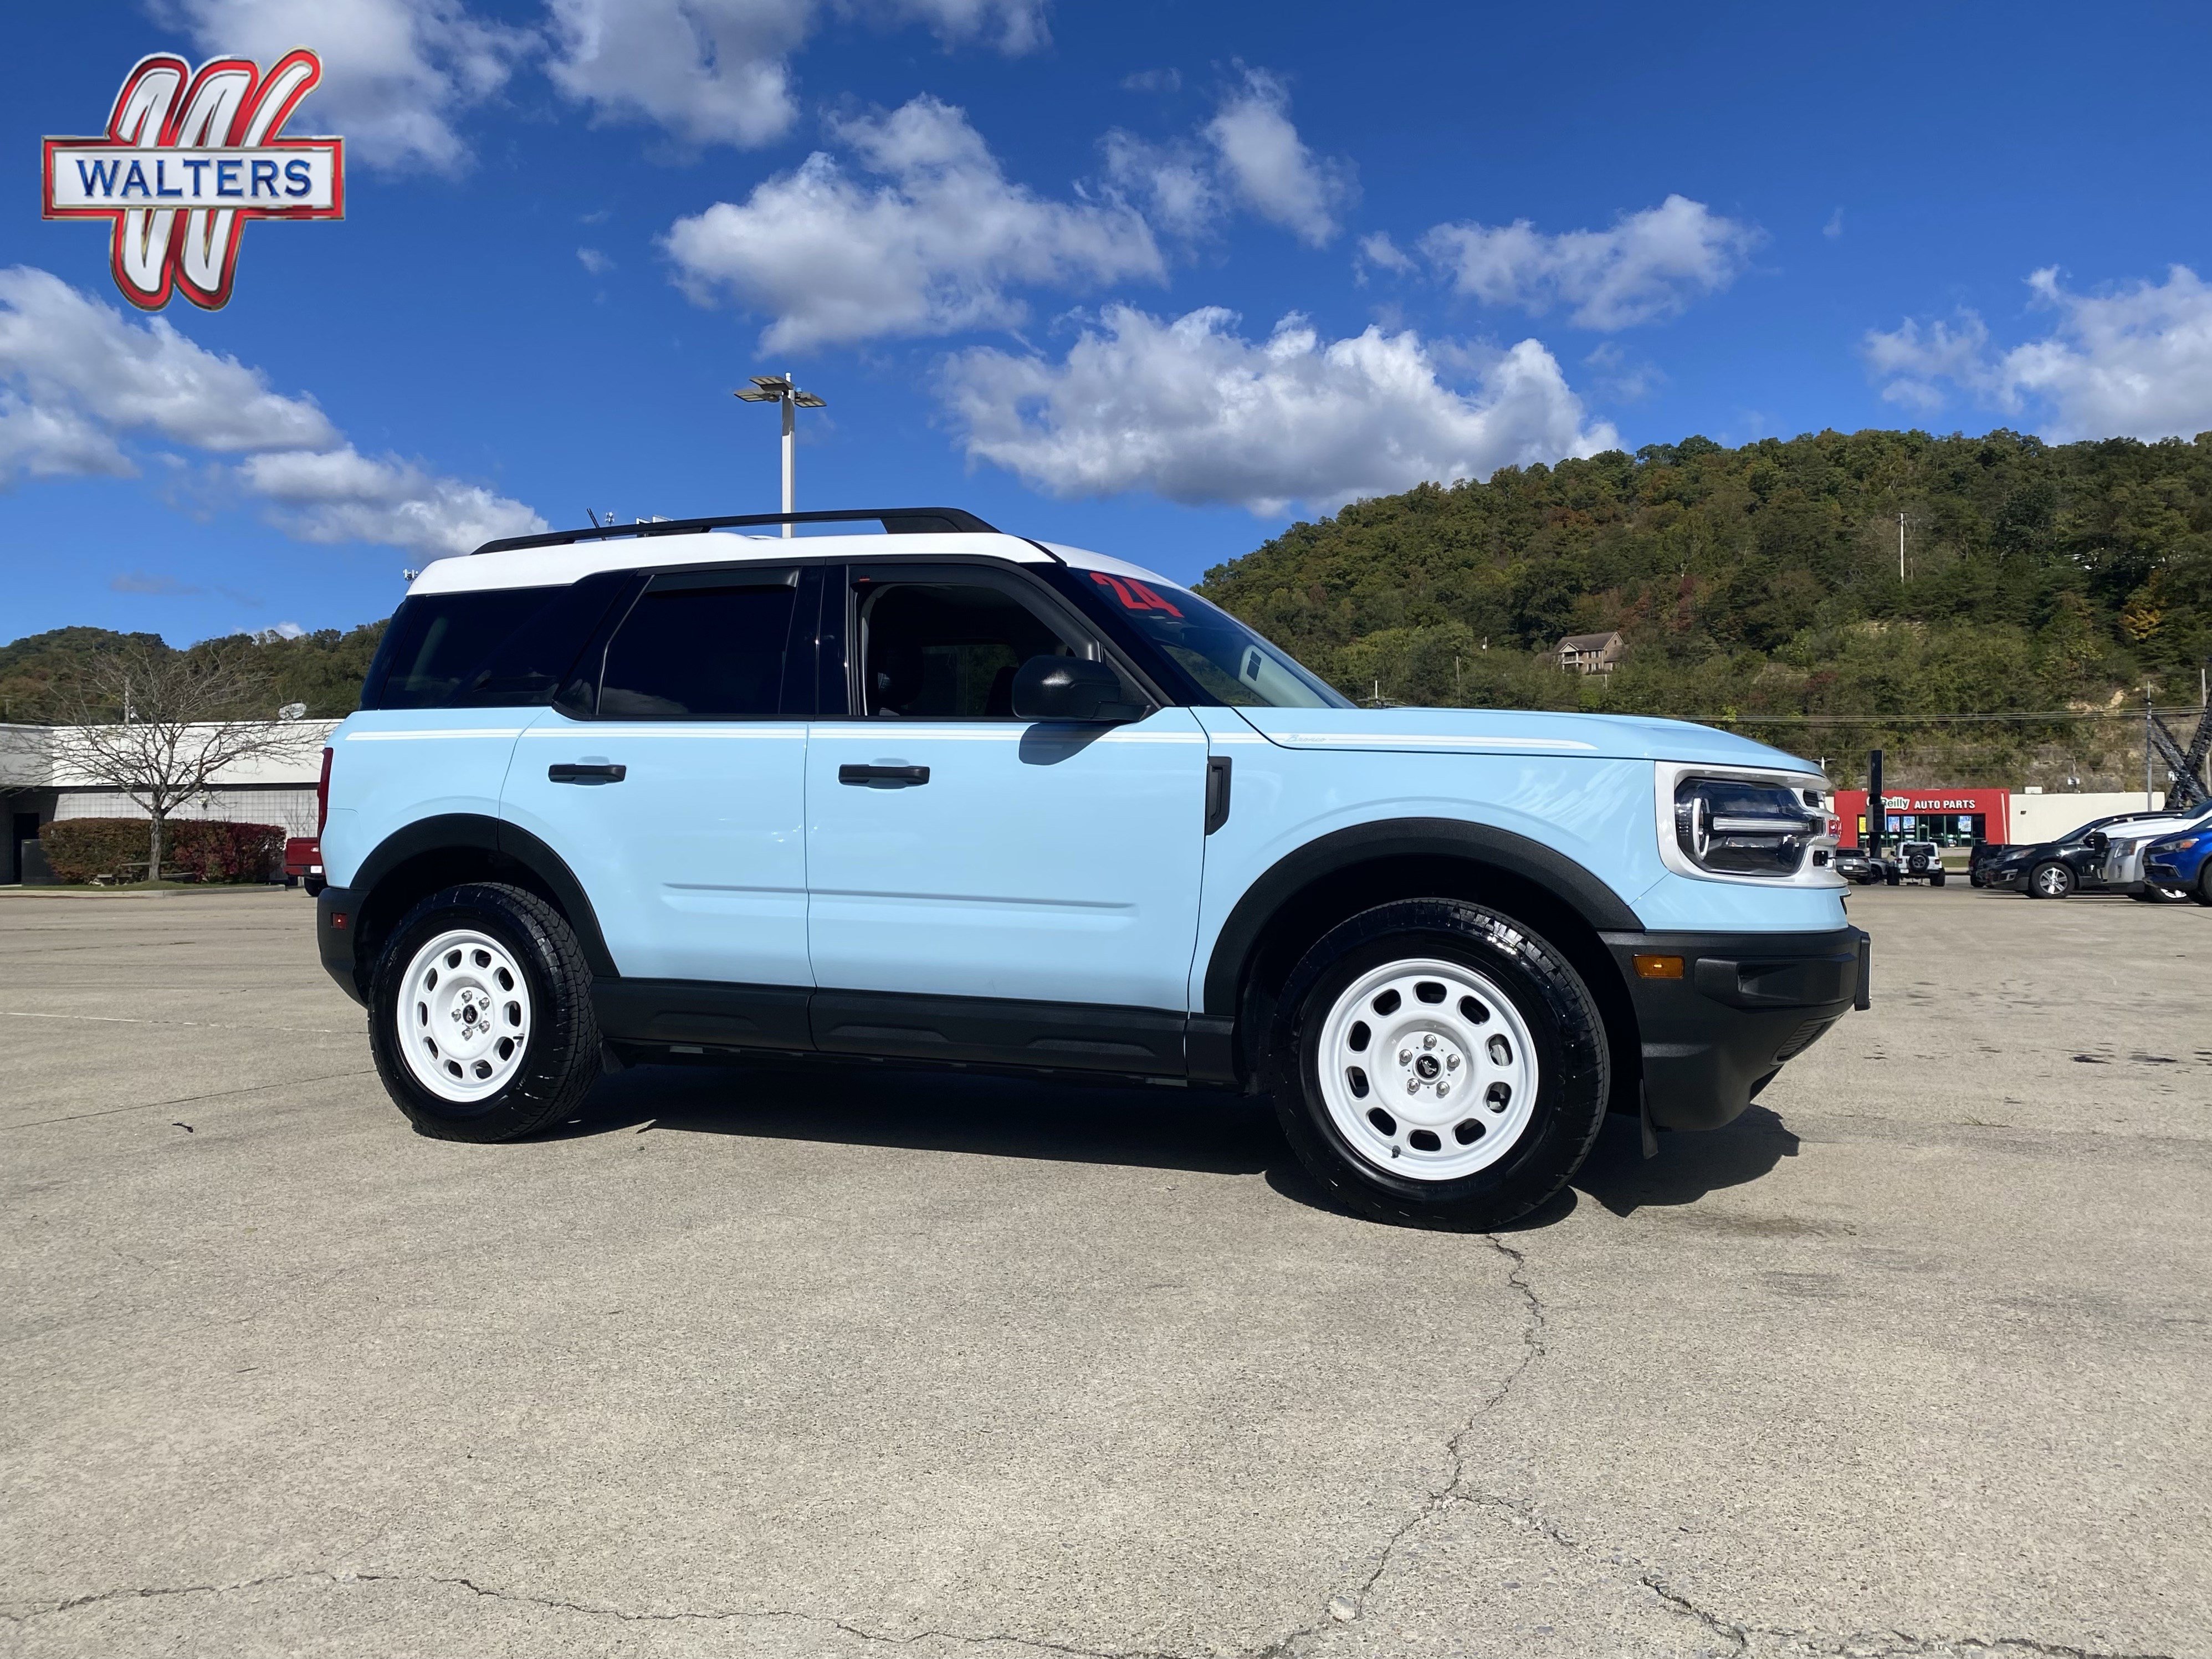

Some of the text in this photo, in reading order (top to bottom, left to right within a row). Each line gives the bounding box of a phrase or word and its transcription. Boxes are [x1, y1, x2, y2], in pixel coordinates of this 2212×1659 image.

[1089, 572, 1185, 618] 24
[1866, 796, 1975, 810] Reilly AUTO PARTS
